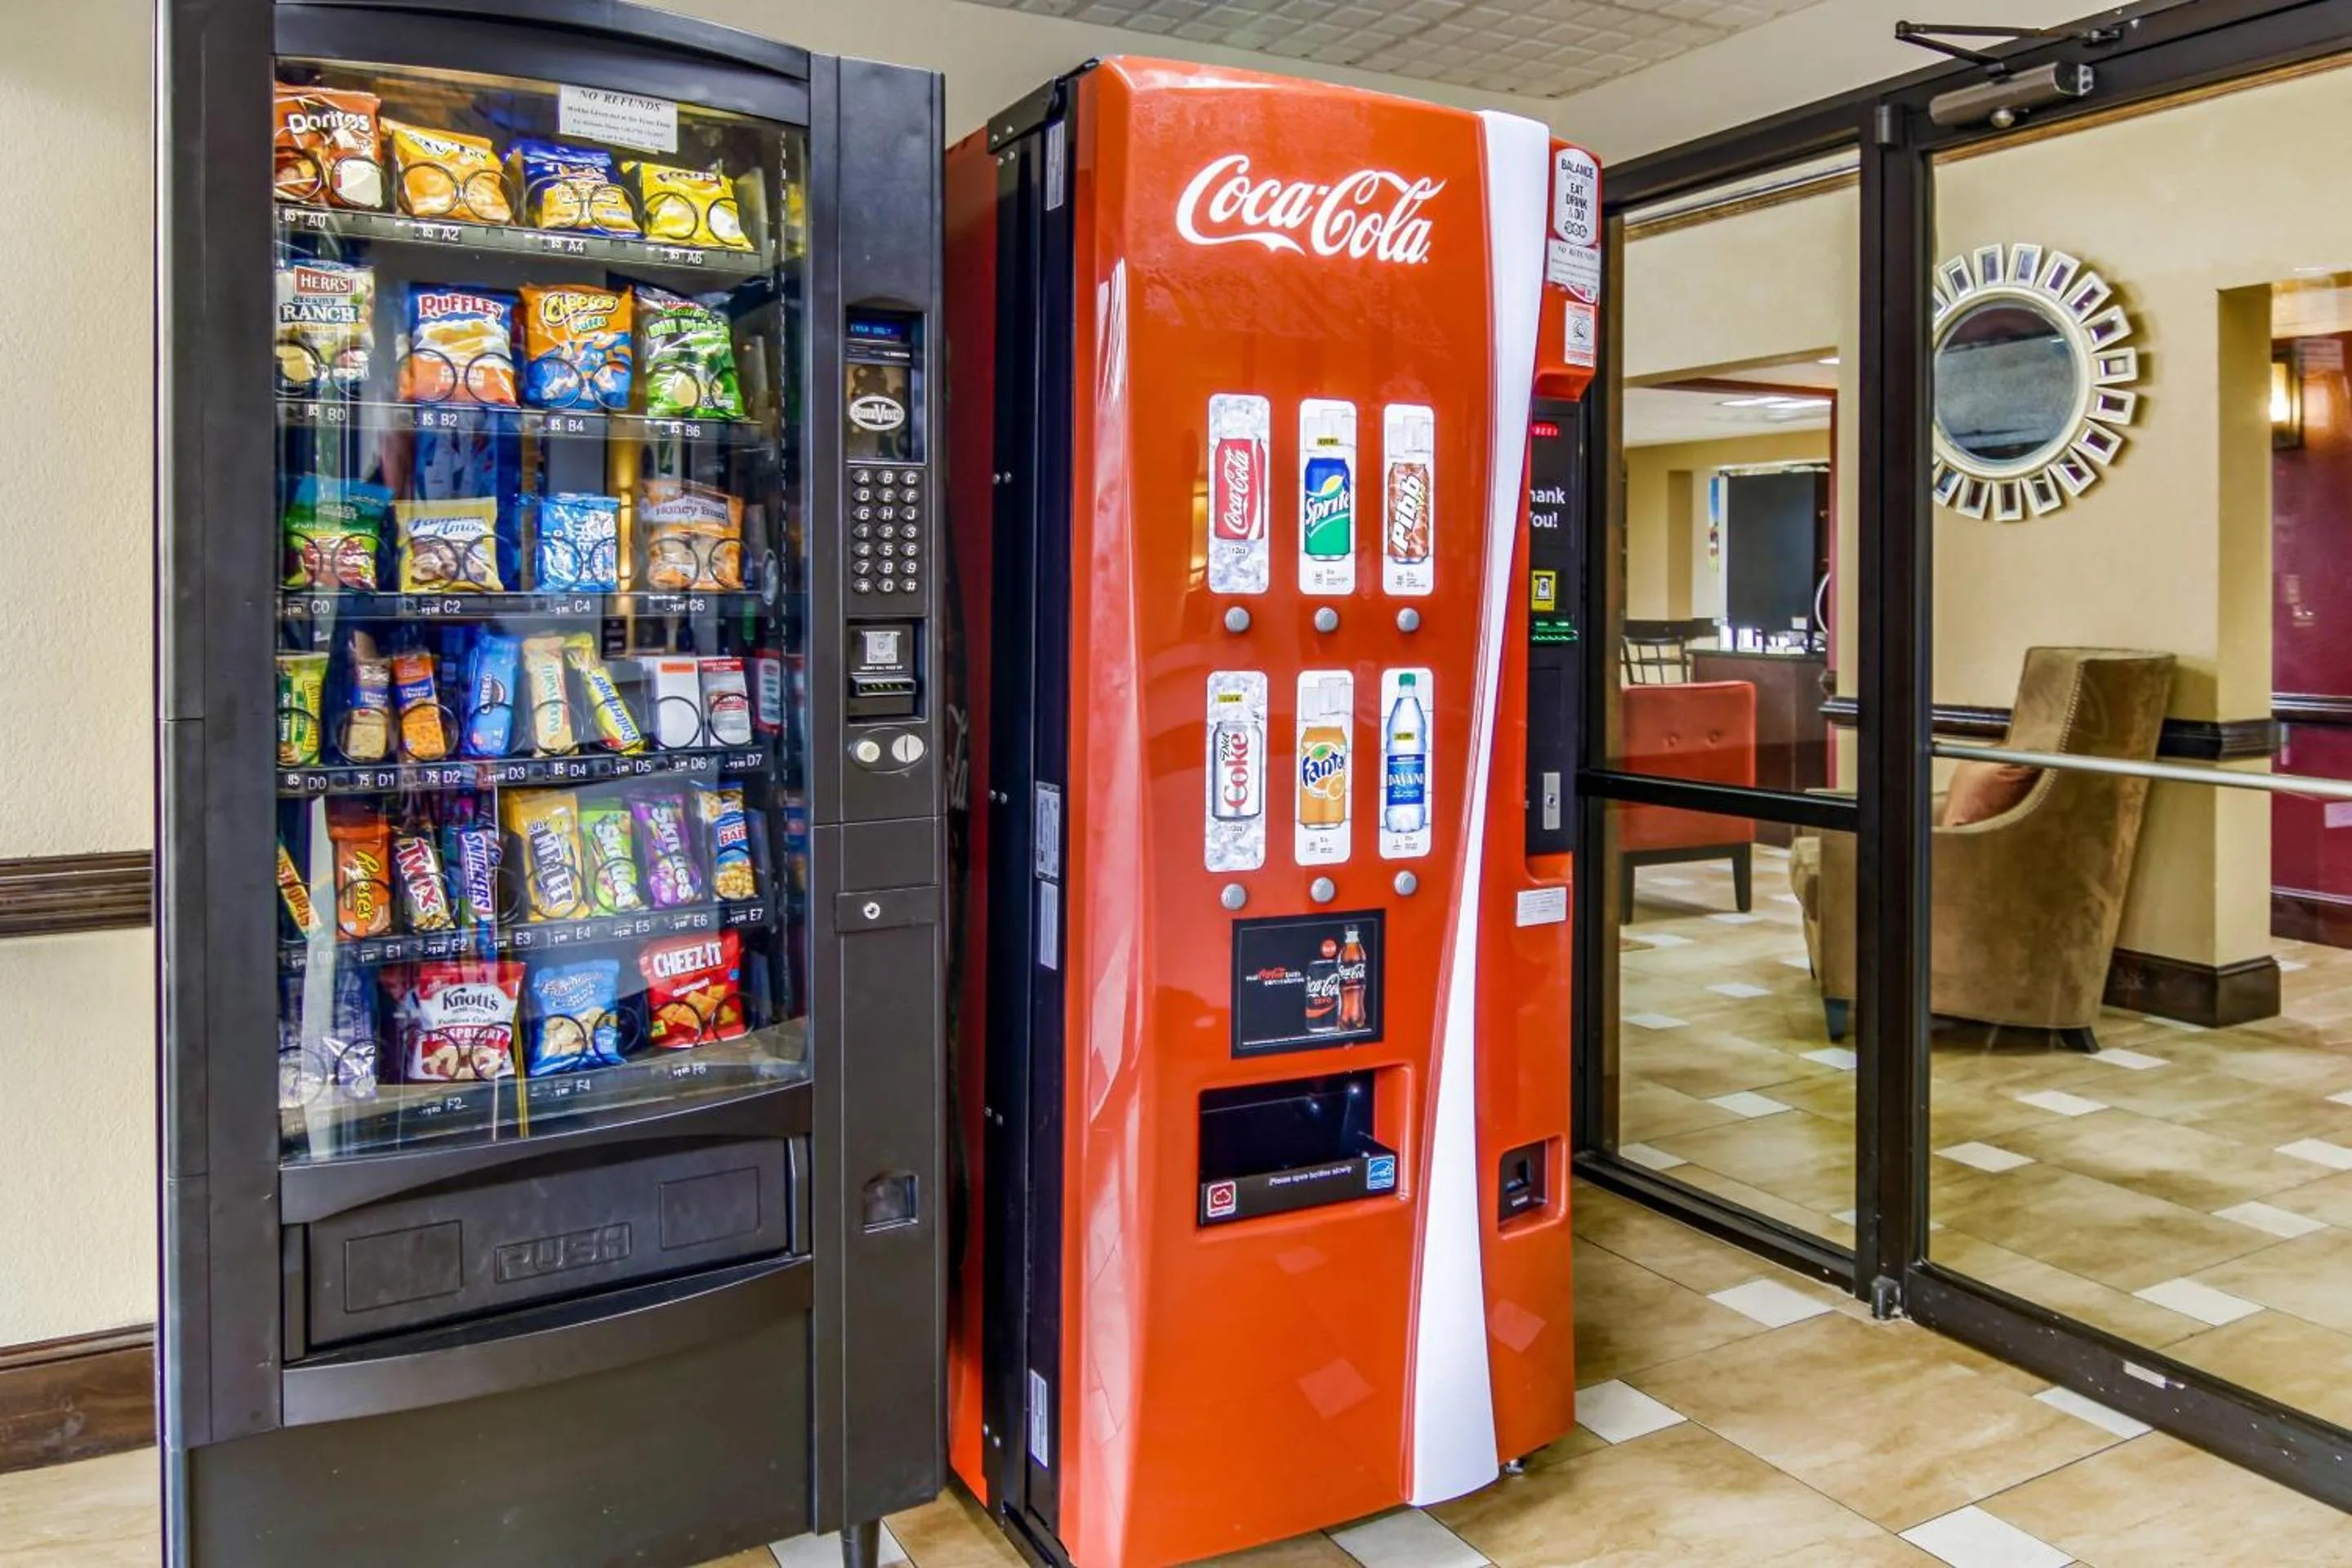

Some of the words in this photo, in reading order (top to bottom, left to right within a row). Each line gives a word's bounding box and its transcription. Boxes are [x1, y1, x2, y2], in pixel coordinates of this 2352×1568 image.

[581, 89, 598, 100] NO
[604, 94, 662, 111] REFUNDS
[288, 111, 370, 133] Doritos
[1561, 158, 1594, 179] BALANCE
[1570, 183, 1584, 196] EAT
[1566, 193, 1588, 211] DRINK
[1177, 154, 1447, 265] Coca-Cola
[308, 215, 325, 228] A0
[441, 226, 459, 240] A2
[568, 241, 584, 253] A4
[686, 252, 702, 264] A6
[301, 274, 348, 292] HERR'S
[292, 296, 336, 305] creamy
[420, 293, 504, 319] RUFFLES
[283, 305, 357, 322] RANCH
[327, 408, 345, 421] B0
[442, 414, 457, 427] B2
[568, 420, 584, 432] B4
[686, 425, 701, 439] B6
[860, 473, 869, 483] A
[884, 474, 893, 483] B
[906, 474, 916, 484] C
[1224, 443, 1250, 535] Coca-Cola
[860, 491, 869, 501] D
[884, 492, 893, 501] E
[906, 492, 915, 502] F
[1306, 489, 1351, 525] Sprite
[860, 509, 869, 519] G
[884, 509, 893, 519] H
[906, 510, 915, 520] J
[1530, 511, 1557, 528] ou!
[862, 527, 868, 537] 1
[884, 527, 893, 537] 2
[906, 528, 916, 537] 3
[860, 546, 868, 555] 4
[884, 546, 893, 556] 5
[906, 546, 916, 556] 6
[860, 563, 869, 573] 7
[884, 563, 893, 573] 8
[906, 563, 916, 573] 9
[311, 600, 329, 614] C0
[444, 600, 461, 613] C2
[575, 600, 590, 612] C4
[689, 599, 705, 611] C6
[636, 760, 652, 773] D5
[691, 758, 706, 770] D6
[747, 754, 764, 768] D7
[443, 770, 461, 784] D2
[509, 767, 525, 780] D3
[570, 764, 586, 777] D4
[1224, 733, 1249, 808] Coke
[308, 777, 327, 790] D0
[379, 773, 394, 786] D1
[396, 837, 440, 913] TWIX
[466, 832, 491, 909] SNICKERS
[355, 851, 381, 920] Reese's
[694, 915, 708, 927] E6
[750, 908, 764, 921] E7
[577, 926, 591, 938] E4
[636, 920, 650, 933] E5
[452, 938, 467, 951] E2
[515, 932, 531, 944] E3
[386, 944, 400, 957] E1
[653, 942, 722, 978] CHEEZ-IT
[443, 987, 499, 1011] Knott's
[575, 1080, 590, 1092] F4
[447, 1098, 462, 1111] F2
[1269, 1176, 1290, 1186] Please
[1292, 1174, 1308, 1182] open
[1309, 1170, 1330, 1180] bottles
[1332, 1165, 1352, 1176] slowly
